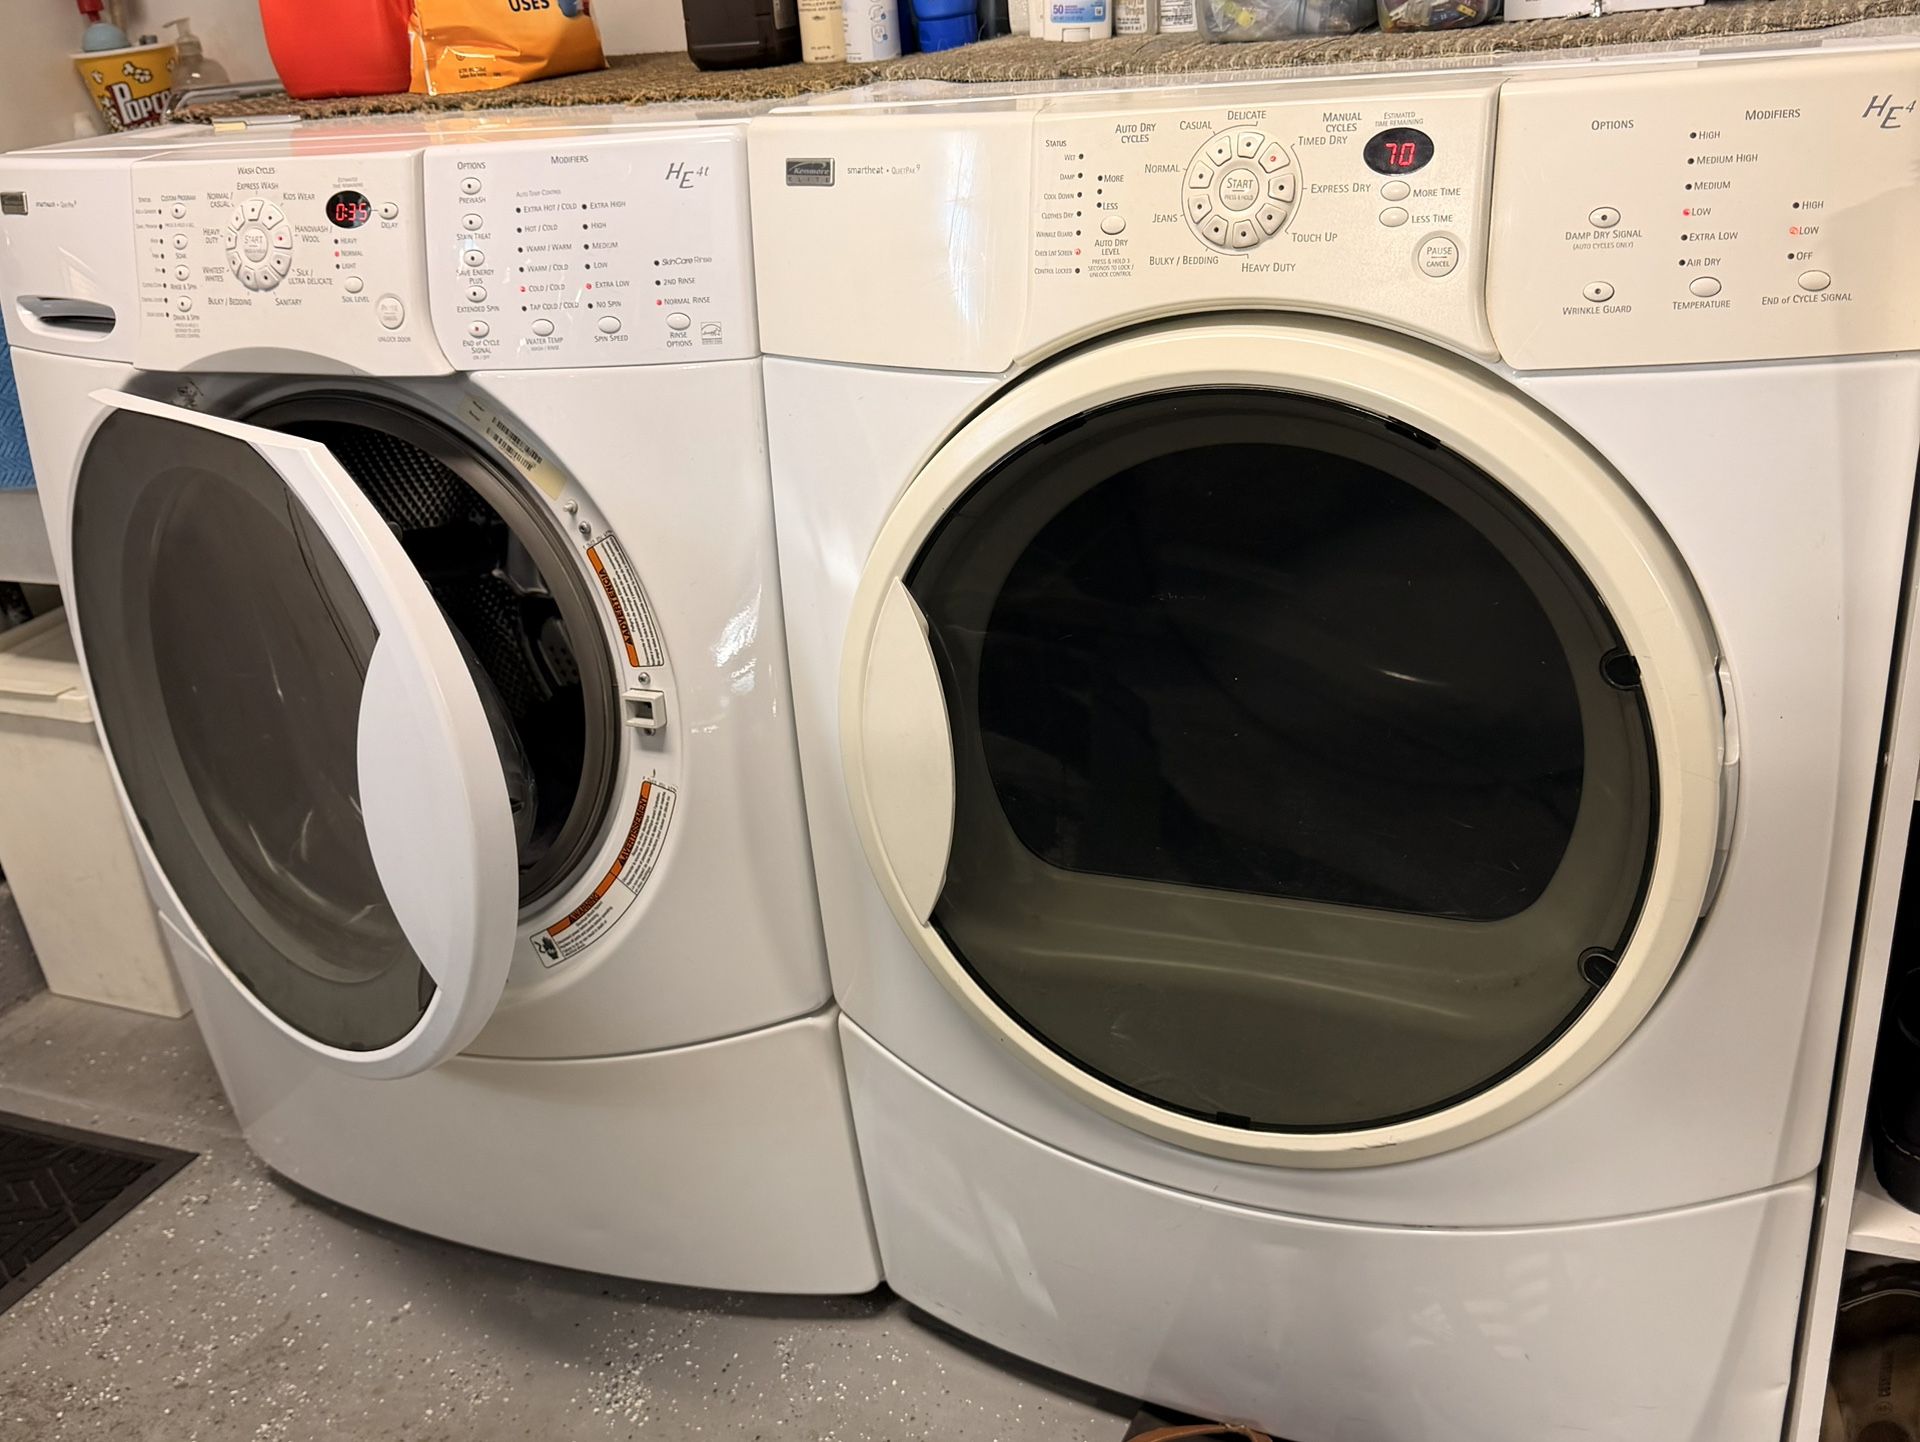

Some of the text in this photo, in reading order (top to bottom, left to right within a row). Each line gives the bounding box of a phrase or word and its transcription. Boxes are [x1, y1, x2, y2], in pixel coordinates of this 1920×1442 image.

[508, 0, 550, 12] USES
[1053, 4, 1064, 15] 50
[1227, 110, 1267, 120] DELICATE
[1322, 112, 1363, 122] MANUAL
[1383, 112, 1416, 120] ESTIMATED
[1745, 108, 1801, 121] MODIFIERS
[1179, 120, 1213, 130] CASUAL
[1389, 118, 1424, 126] REMAINING
[1591, 119, 1635, 131] OPTIONS
[1115, 122, 1156, 133] AUTO DRY
[1325, 123, 1358, 133] CYCLES
[1120, 134, 1150, 143] CYCLES
[1698, 130, 1721, 140] HIGH
[1045, 139, 1067, 147] STATUS
[1298, 135, 1348, 146] TIMED DRY
[1385, 142, 1416, 166] 70
[551, 155, 589, 164] MODIFIERS
[1696, 153, 1759, 165] MEDIUM HIGH
[457, 161, 486, 170] OPTIONS
[1144, 164, 1180, 173] NORMAL
[237, 166, 276, 175] WASH CYCLES
[793, 167, 830, 176] Kenmore
[847, 166, 884, 175] smartheat
[1103, 174, 1125, 182] MORE
[236, 182, 279, 191] EXPRESS WASH
[1226, 178, 1254, 189] START
[1310, 182, 1372, 194] EXPRESS DRY
[1694, 181, 1731, 190] MEDIUM
[206, 192, 229, 200] NORMAL
[283, 192, 297, 200] KIDS
[1413, 187, 1461, 198] MORE TIME
[523, 205, 541, 213] EXTRA
[543, 204, 555, 212] HOT
[590, 202, 609, 210] EXTRA
[1102, 202, 1119, 210] LESS
[1802, 201, 1824, 210] HIGH
[336, 203, 368, 221] 0:35
[1063, 211, 1074, 219] DRY
[1691, 207, 1712, 217] LOW
[1152, 213, 1178, 223] JEANS
[1411, 214, 1453, 224] LESS TIME
[202, 228, 220, 236] HEAVY
[294, 225, 328, 233] HANDWASH
[524, 224, 558, 233] HOT COLD
[1799, 226, 1820, 235] LOW
[301, 235, 320, 243] WOOL
[1291, 232, 1338, 243] TOUCH UP
[1565, 229, 1643, 240] DAMP DRY SIGNAL
[1689, 231, 1738, 242] EXTRA LOW
[205, 236, 219, 244] DUTY
[1094, 238, 1128, 247] AUTO DRY
[551, 243, 572, 251] WARM
[592, 242, 618, 250] MEDIUM
[1426, 246, 1453, 255] PAUSE
[1101, 248, 1120, 256] LEVEL
[1796, 251, 1813, 261] OFF
[1149, 255, 1219, 265] BULKY BEDDING
[1426, 260, 1450, 268] CANCEL
[1686, 257, 1721, 267] AIR DRY
[202, 266, 225, 274] WHITEST
[527, 263, 569, 273] WARM COLD
[1241, 262, 1296, 273] HEAVY DUTY
[595, 280, 630, 289] EXTRA LOW
[663, 278, 677, 286] 2ND
[549, 283, 566, 291] COLD
[208, 297, 252, 306] BULKY BEDDING
[275, 297, 302, 306] SANITARY
[692, 296, 711, 304] RINSE
[1761, 293, 1853, 305] END of CYCLE SIGNAL
[456, 305, 485, 313] EXTENDED
[530, 302, 558, 311] TAP COLD
[1672, 300, 1731, 310] TEMPERATURE
[1562, 305, 1632, 315] WRINKLE GUARD
[525, 336, 563, 345] WATER TEMP
[594, 334, 629, 343] SPIN SPEED
[666, 340, 693, 348] OPTIONS
